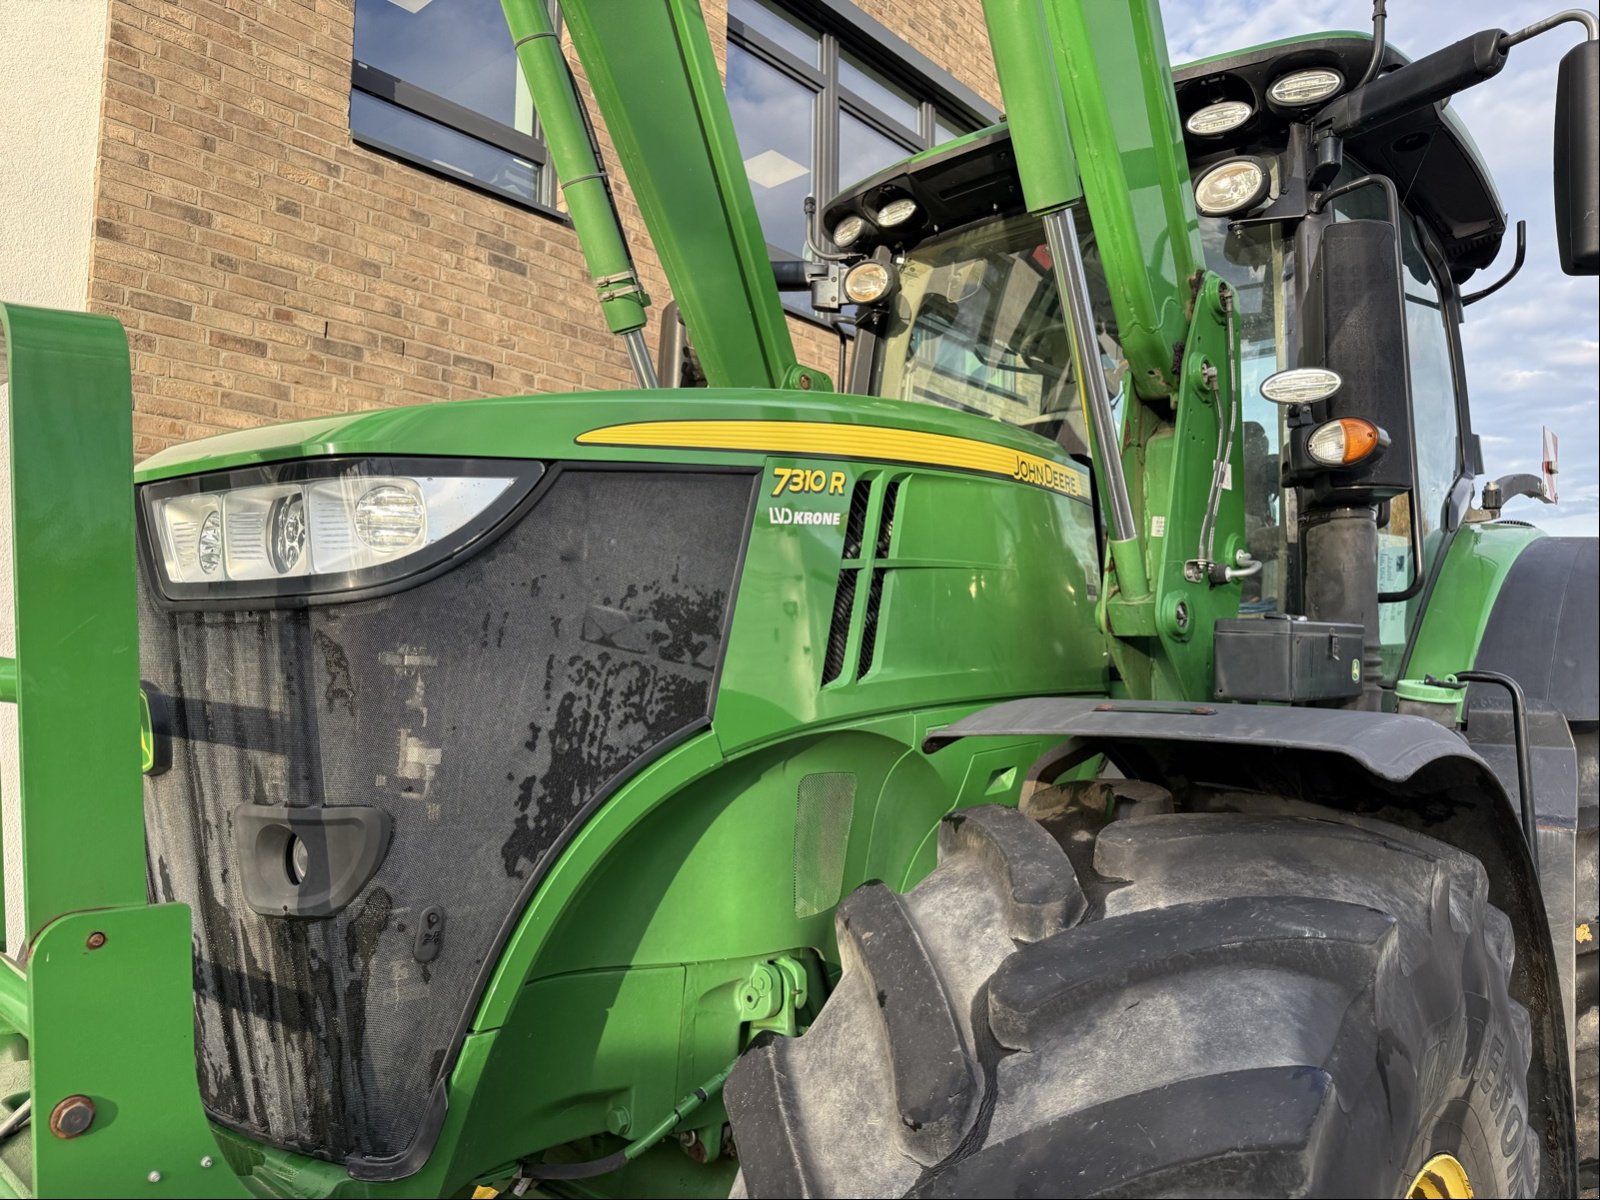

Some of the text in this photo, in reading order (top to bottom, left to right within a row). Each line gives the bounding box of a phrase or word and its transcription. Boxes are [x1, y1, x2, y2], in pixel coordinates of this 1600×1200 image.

[771, 467, 846, 497] 7310 R
[1014, 455, 1077, 494] JOHN DEERE
[793, 511, 841, 526] KRONE
